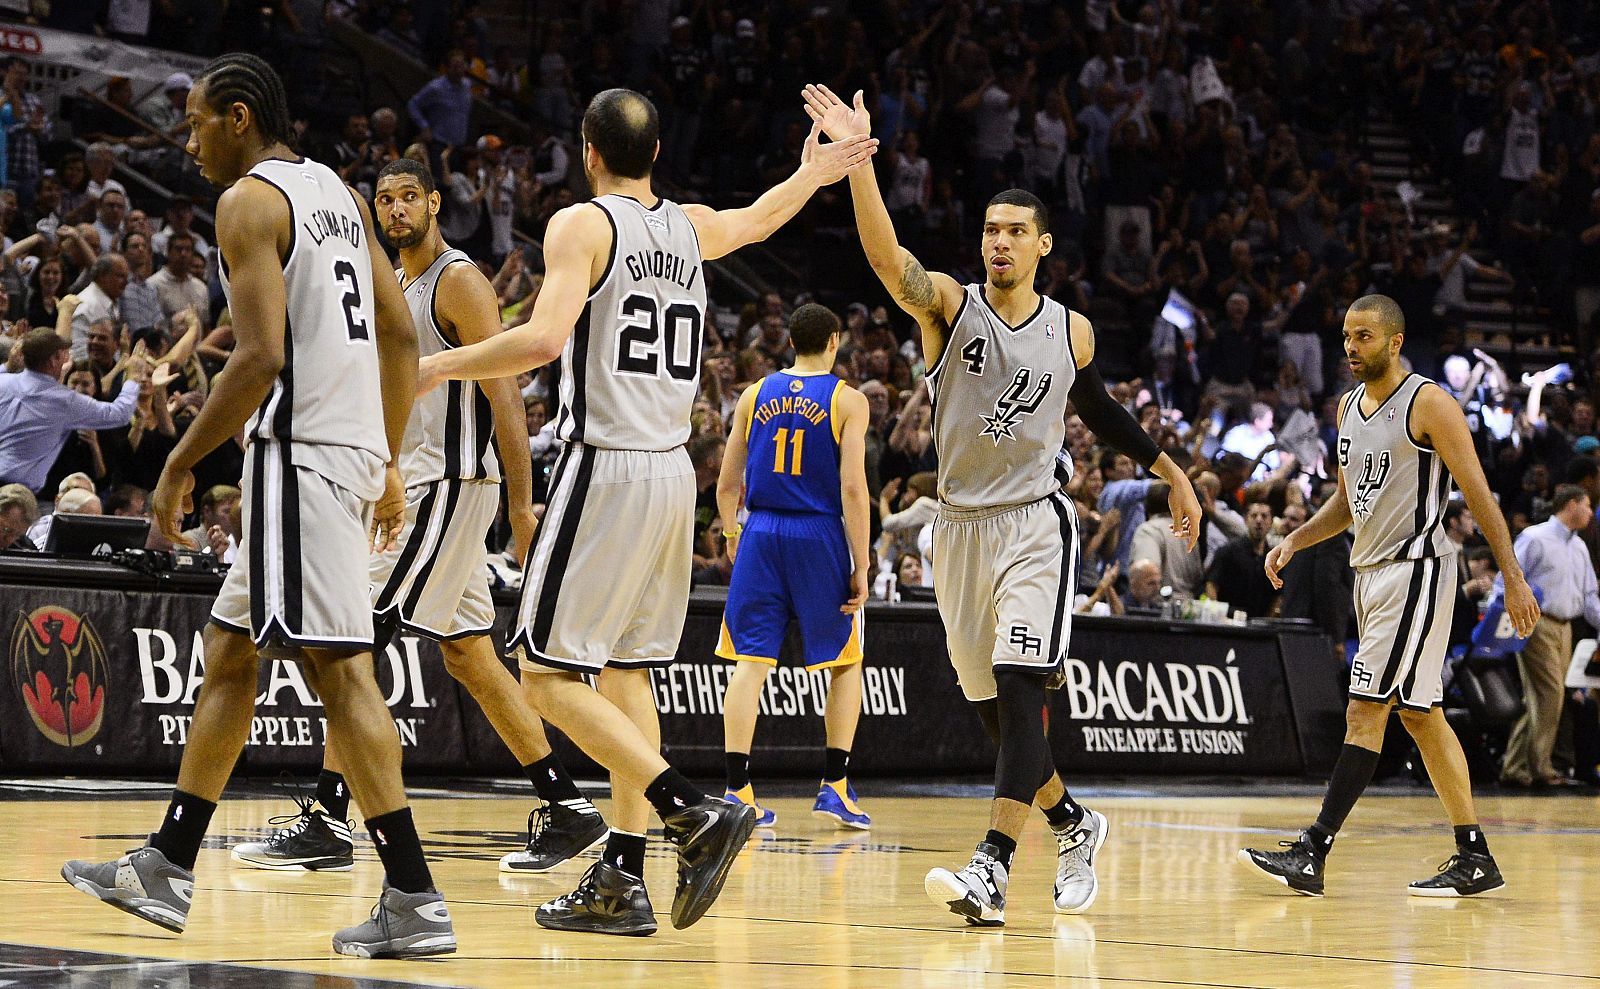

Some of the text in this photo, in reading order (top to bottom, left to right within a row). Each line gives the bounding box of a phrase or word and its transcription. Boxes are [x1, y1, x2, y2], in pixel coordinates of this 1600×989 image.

[304, 209, 360, 249] LEONARD
[625, 249, 698, 290] GINOBILI
[332, 258, 370, 343] 2
[614, 291, 701, 383] 20
[961, 335, 988, 376] 4
[754, 396, 828, 426] THOMPSON
[772, 427, 806, 476] 11
[1339, 437, 1352, 468] 9
[1082, 726, 1245, 755] PINEAPPLE FUSION
